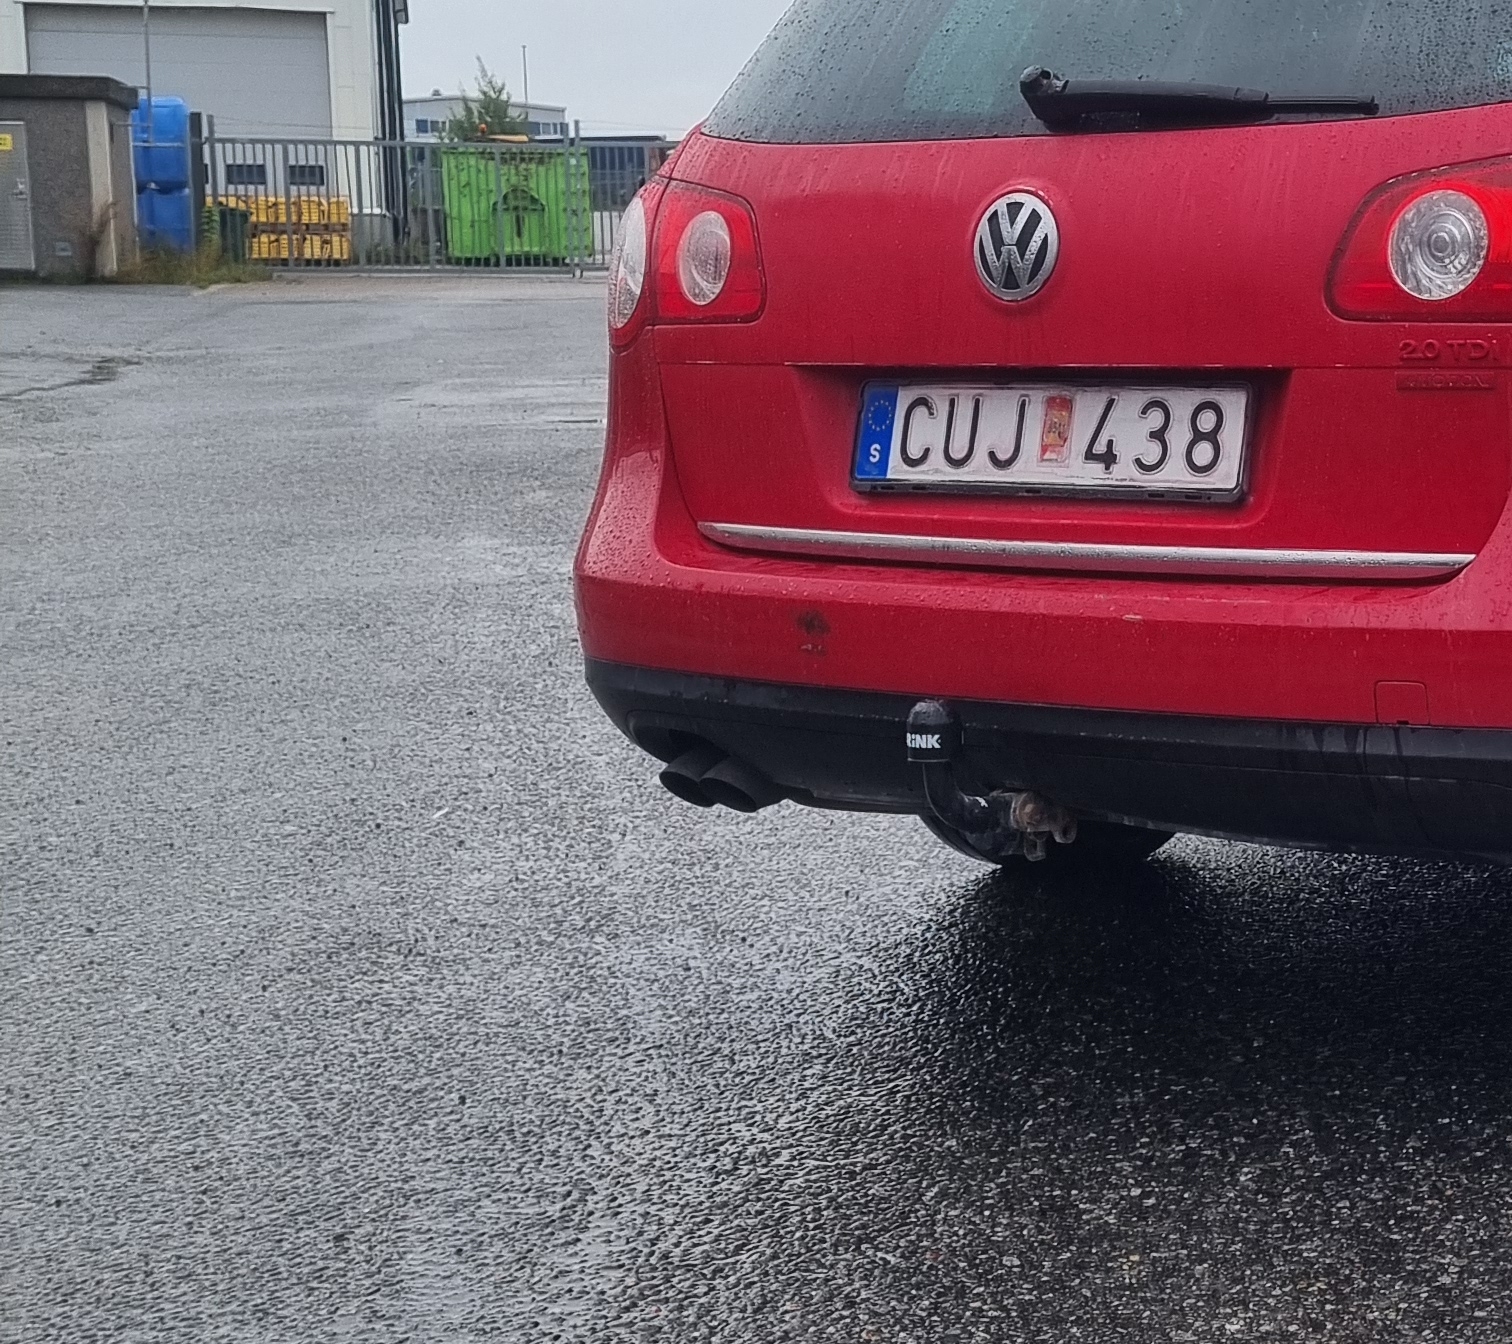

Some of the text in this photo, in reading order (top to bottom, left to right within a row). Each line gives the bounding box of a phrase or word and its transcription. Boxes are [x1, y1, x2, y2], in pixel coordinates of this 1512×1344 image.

[869, 444, 881, 463] S
[900, 396, 1227, 475] CUJ 438
